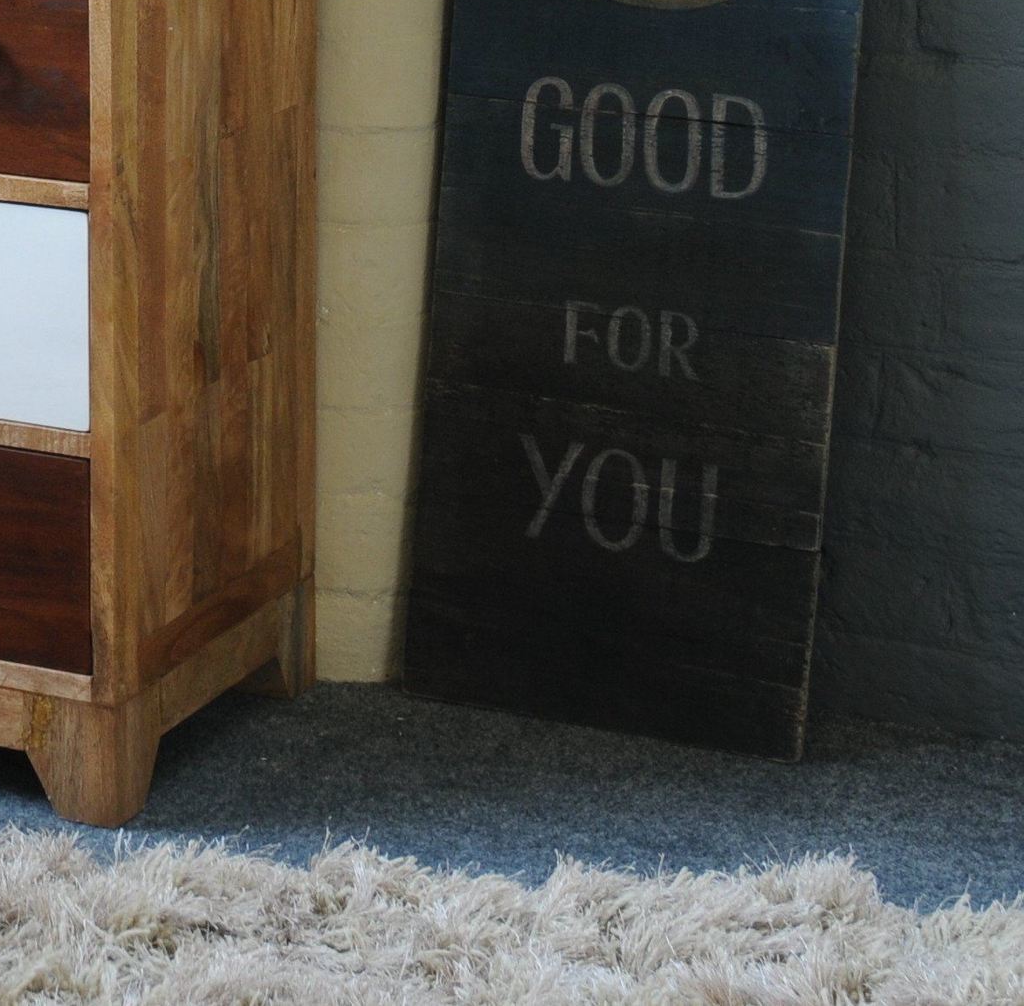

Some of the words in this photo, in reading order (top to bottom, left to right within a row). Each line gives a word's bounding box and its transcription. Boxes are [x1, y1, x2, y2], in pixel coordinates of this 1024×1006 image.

[520, 76, 769, 199] GOOD
[563, 300, 700, 381] FOR
[518, 432, 719, 563] YOU
